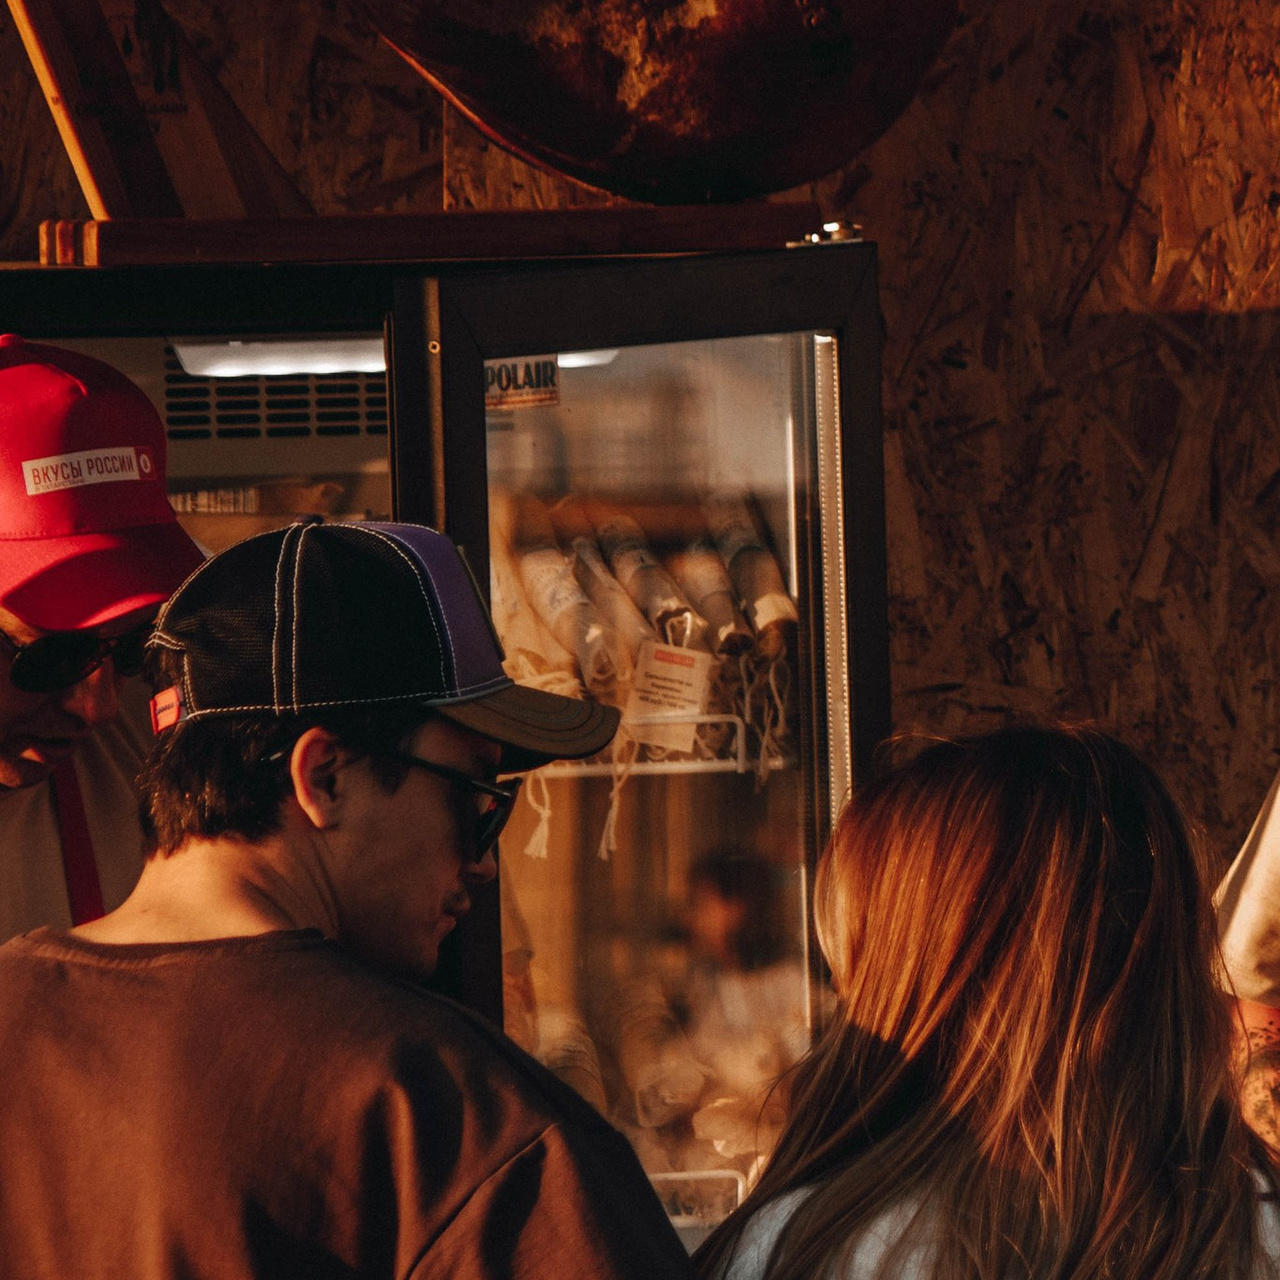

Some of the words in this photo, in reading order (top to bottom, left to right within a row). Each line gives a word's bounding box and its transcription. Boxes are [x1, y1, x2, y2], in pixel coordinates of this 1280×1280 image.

[484, 361, 556, 393] POLAIR
[32, 460, 83, 485] ВКУСЫ
[86, 455, 134, 476] РОССИИ
